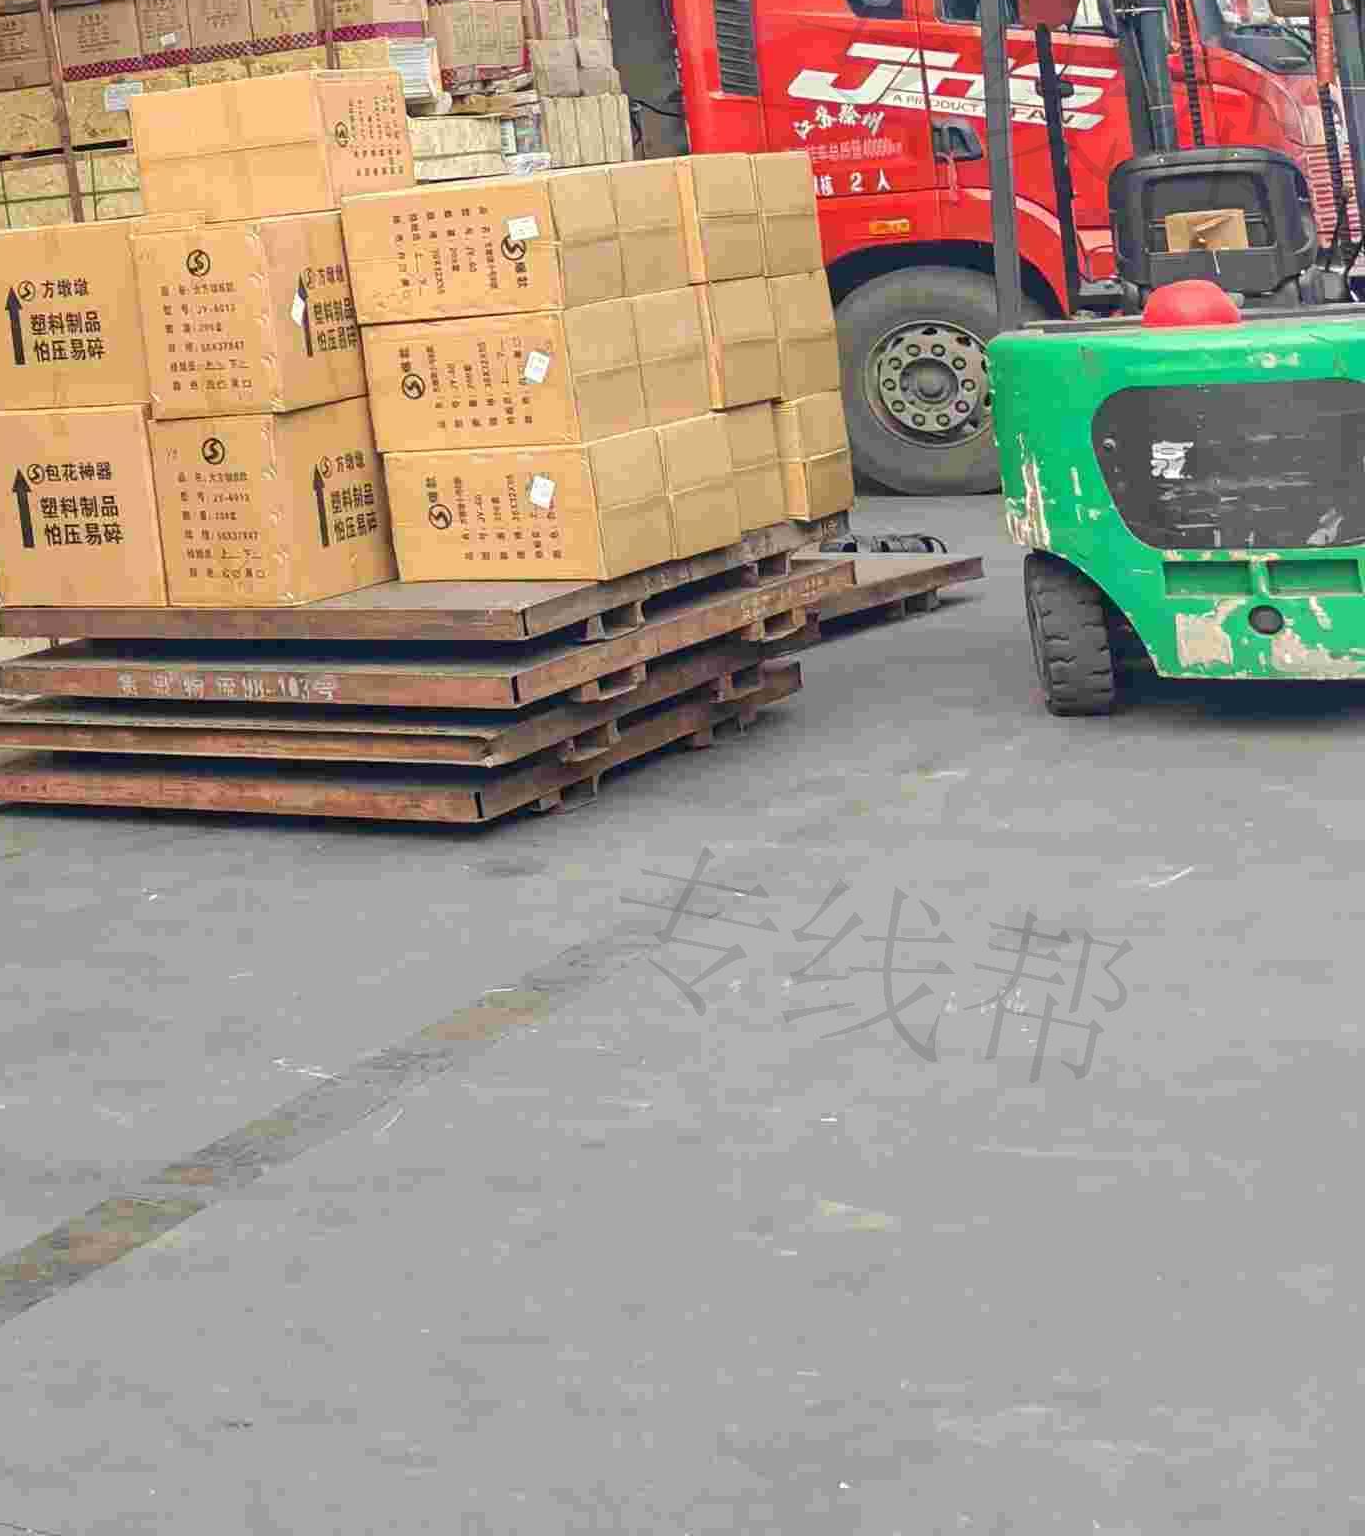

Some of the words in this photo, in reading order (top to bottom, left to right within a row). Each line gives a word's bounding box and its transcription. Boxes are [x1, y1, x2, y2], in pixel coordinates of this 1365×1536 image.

[906, 95, 983, 114] PRODUCT
[850, 171, 864, 193] 2
[876, 167, 892, 192] 人
[30, 311, 101, 336] 塑料制品
[33, 336, 104, 364] 怕压易碎
[40, 495, 119, 519] 塑料制品
[44, 522, 124, 547] 怕压易碎
